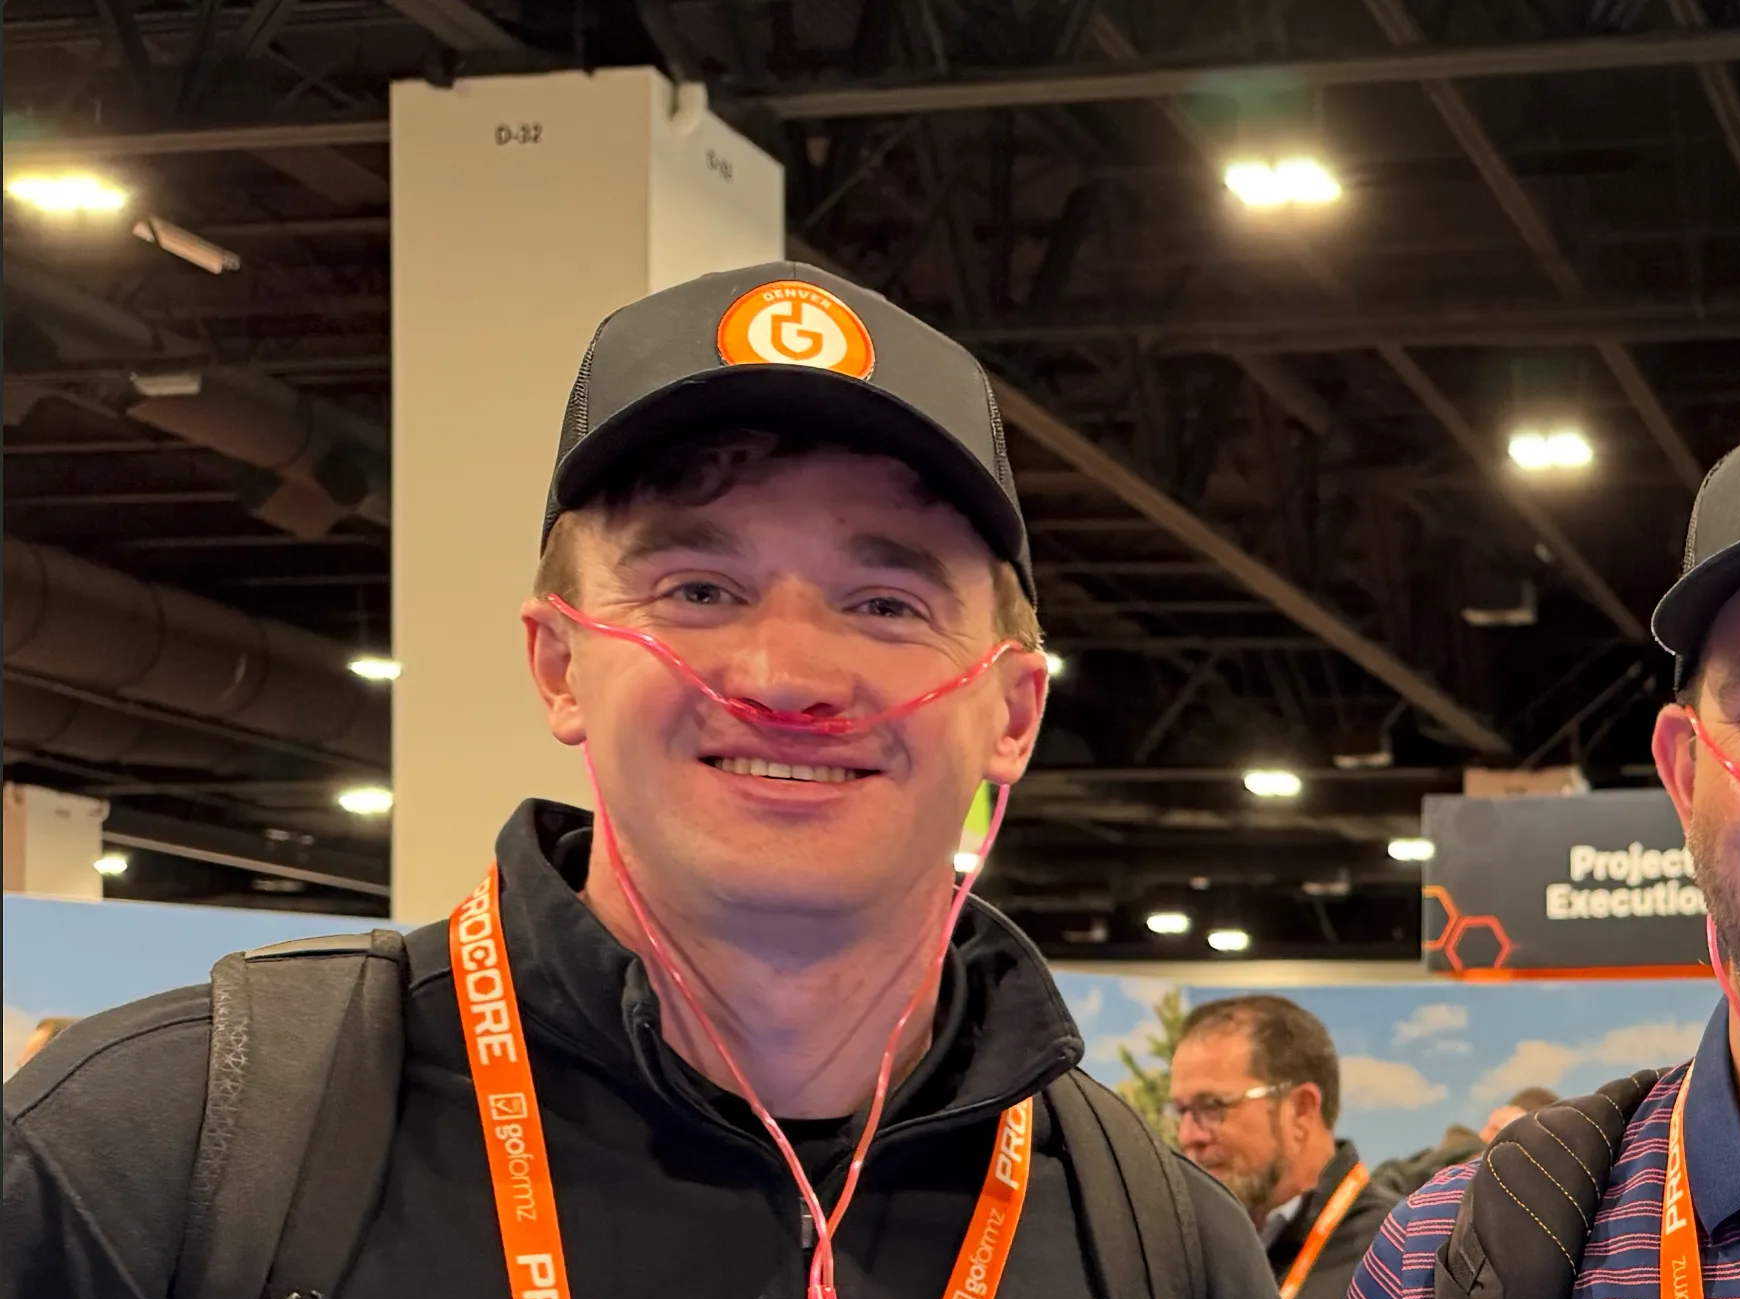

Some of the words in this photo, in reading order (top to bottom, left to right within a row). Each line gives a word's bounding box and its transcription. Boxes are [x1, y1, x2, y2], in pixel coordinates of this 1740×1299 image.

[762, 288, 831, 309] DENVER
[496, 1123, 537, 1222] goformz
[965, 1207, 1006, 1295] goformz
